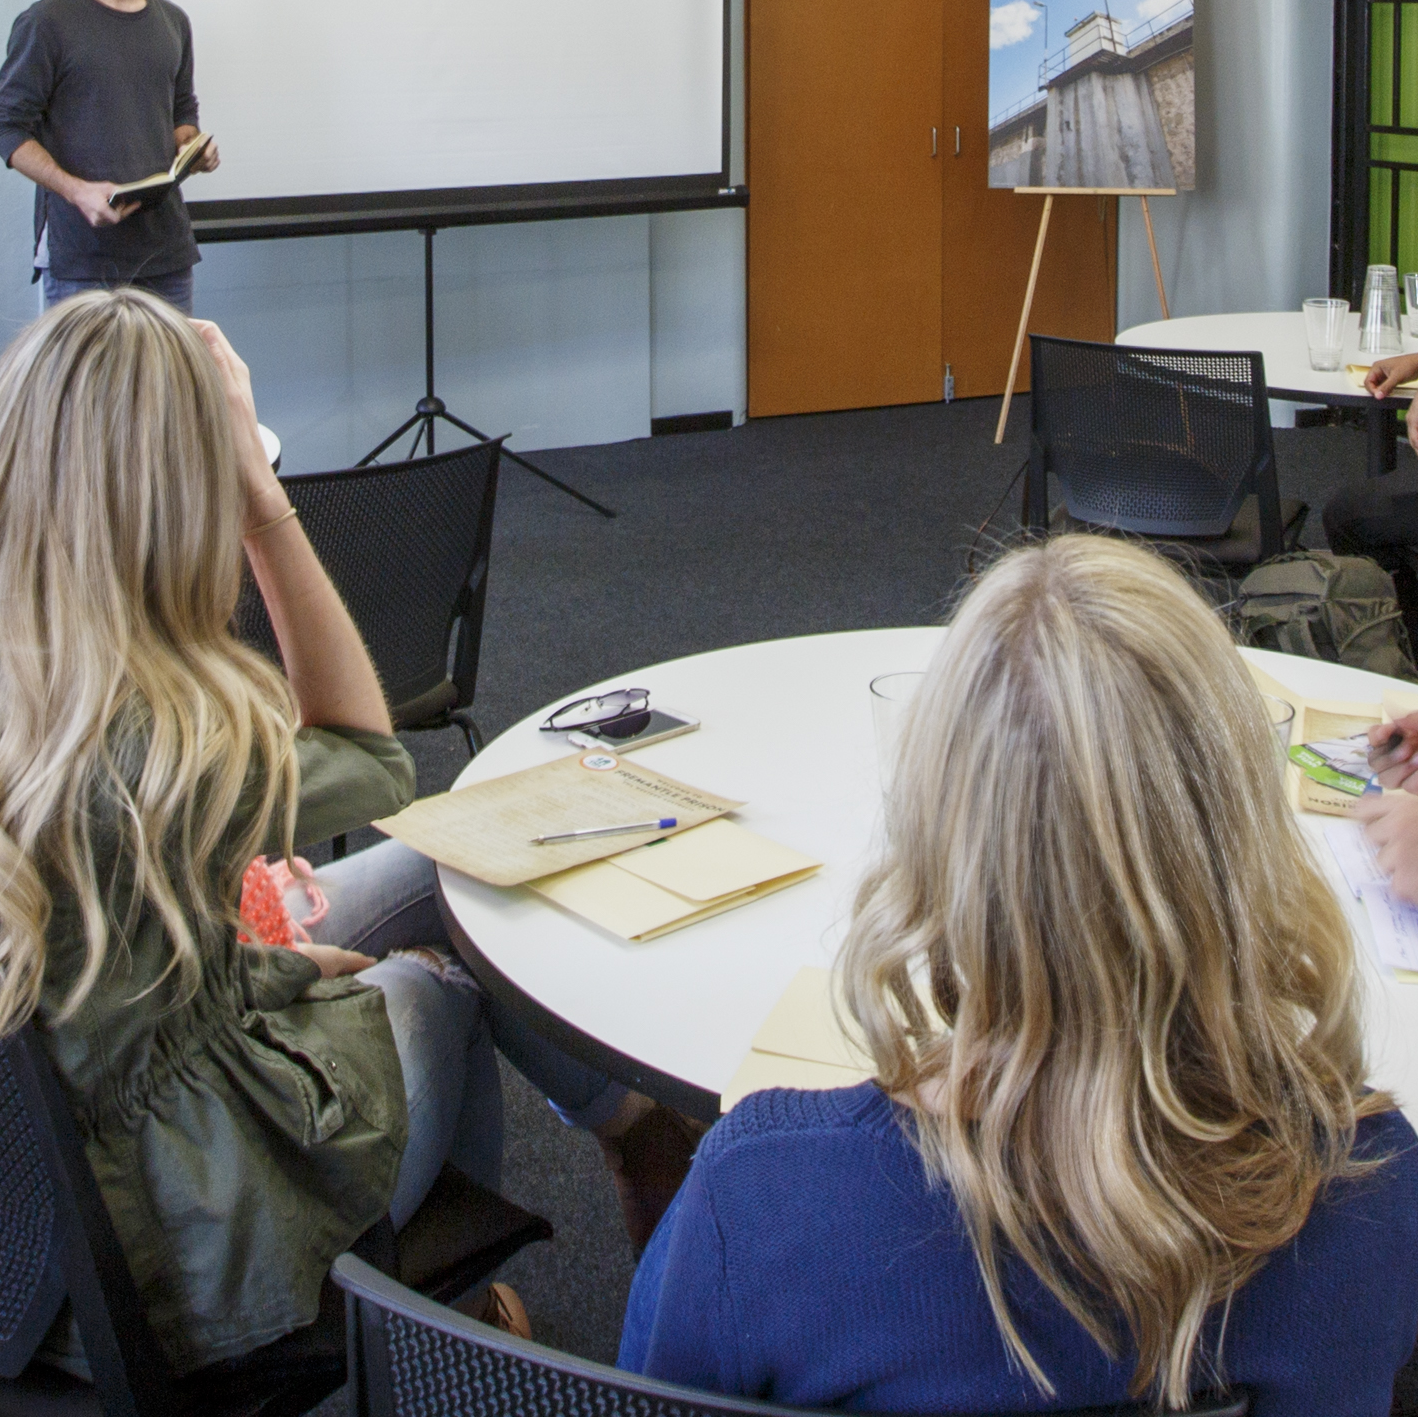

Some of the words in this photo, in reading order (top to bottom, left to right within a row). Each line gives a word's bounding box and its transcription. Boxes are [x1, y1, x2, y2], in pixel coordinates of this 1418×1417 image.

[614, 769, 681, 798] FREMANTLE
[681, 795, 726, 812] PRISON
[1308, 796, 1356, 809] RISON
